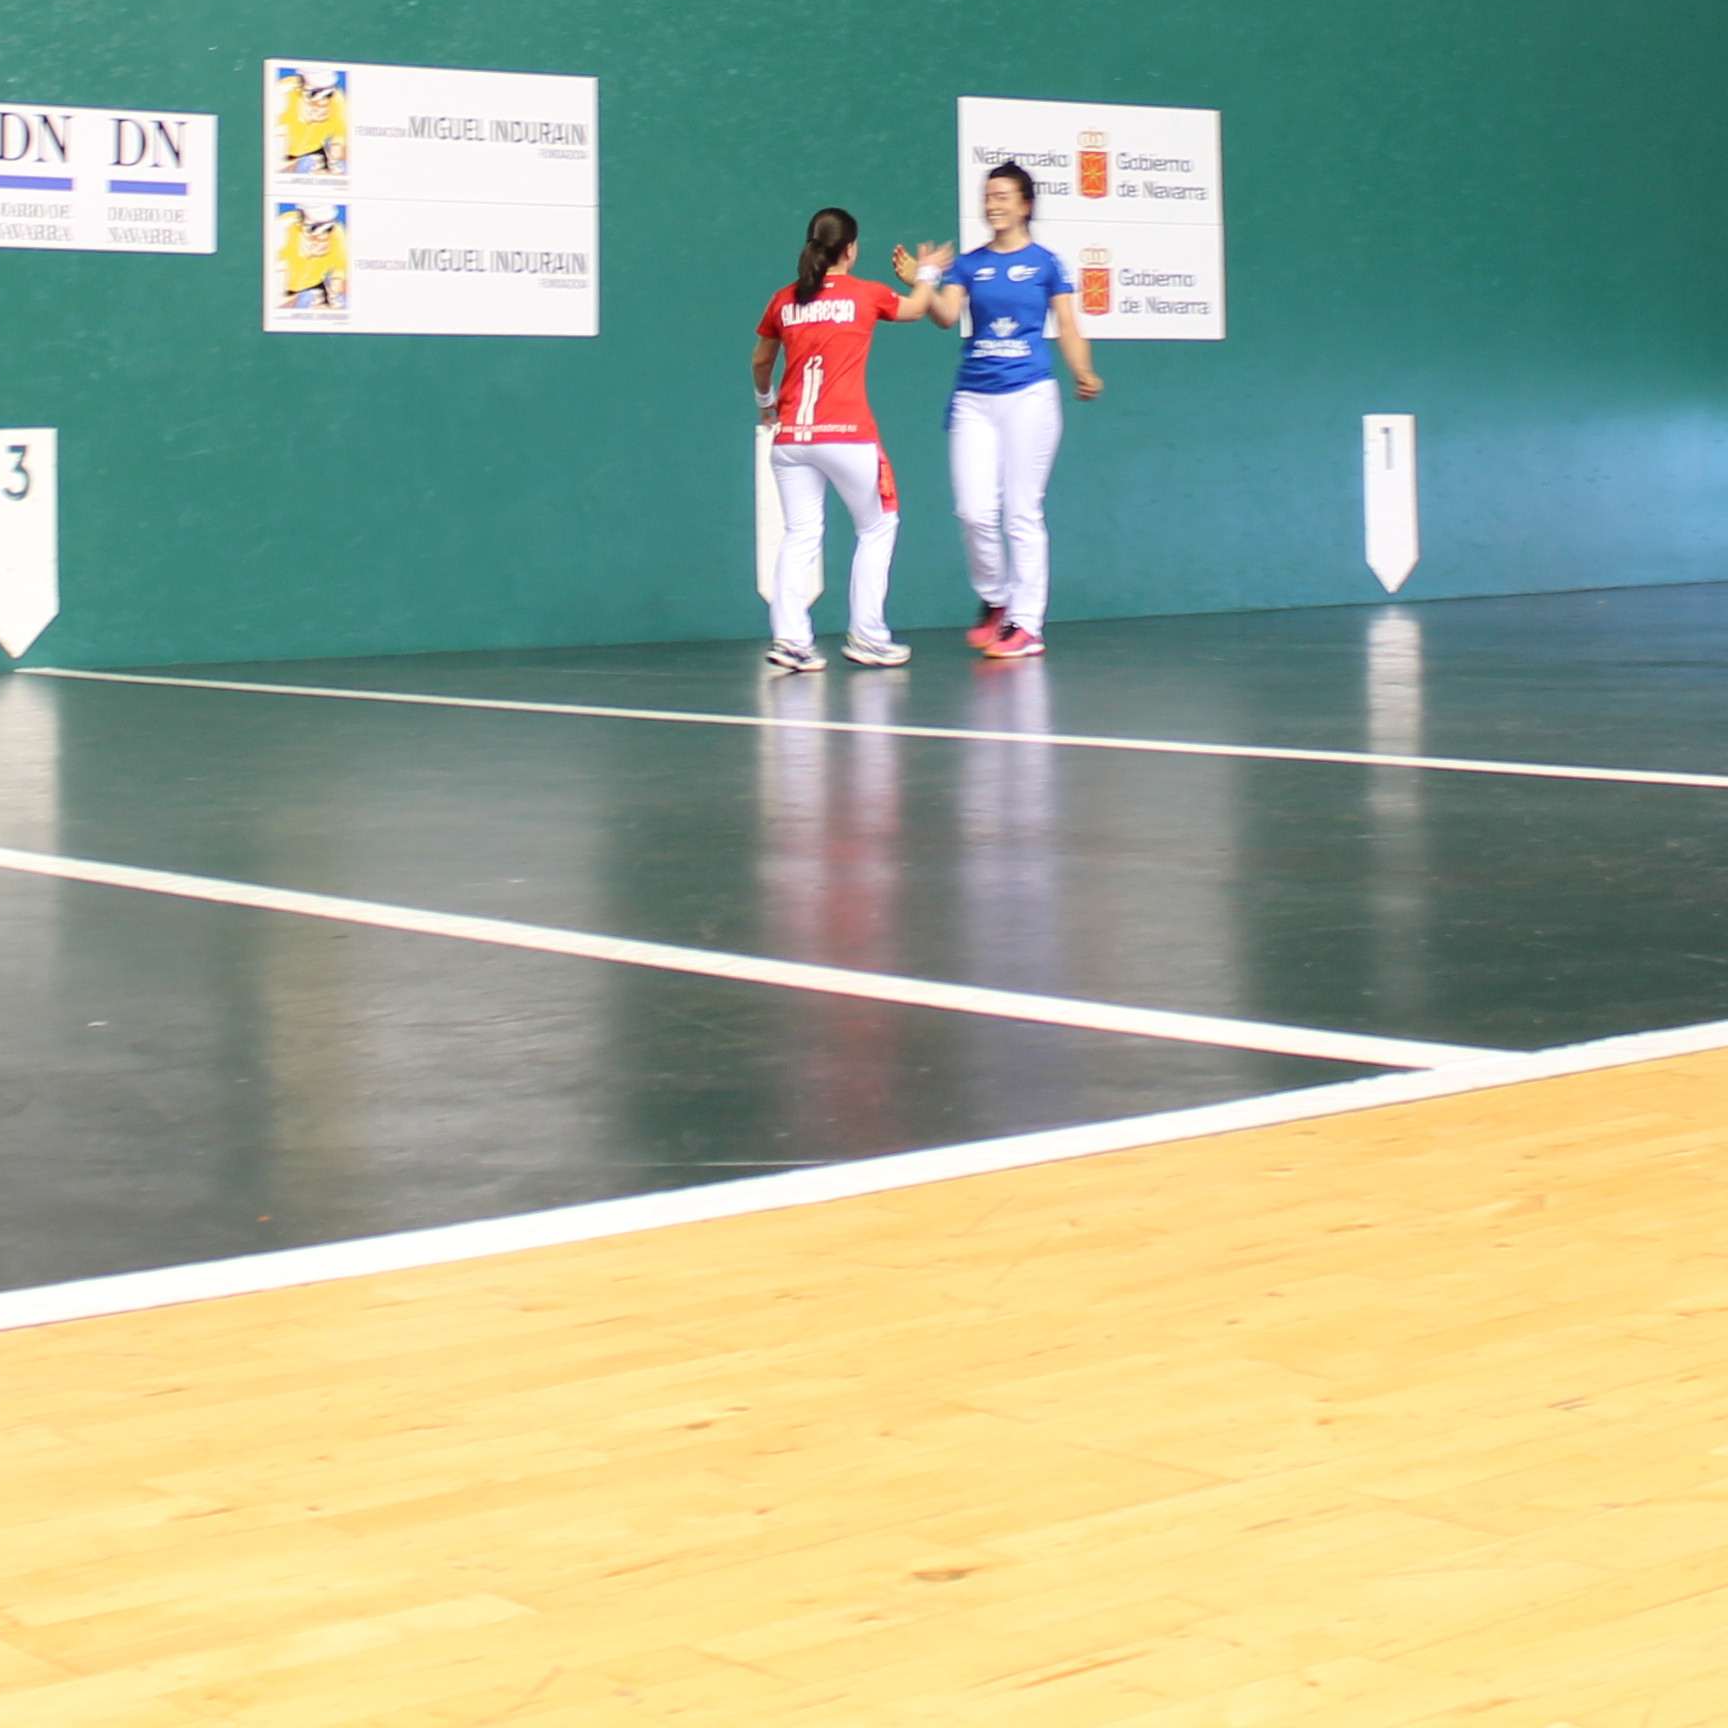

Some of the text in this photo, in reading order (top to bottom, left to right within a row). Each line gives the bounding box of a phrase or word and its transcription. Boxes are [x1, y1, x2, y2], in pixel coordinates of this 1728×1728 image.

[408, 115, 487, 142] MIGUEL
[109, 118, 190, 169] DN
[972, 146, 1070, 168] Nafarroako
[1116, 152, 1194, 172] Gobierno
[1117, 181, 1208, 200] de Navarra
[49, 203, 72, 220] DE
[107, 206, 188, 224] DIARIO DE
[107, 226, 189, 246] NAVARRA
[408, 247, 487, 273] MIGUEL
[1119, 268, 1196, 287] Gobierno
[1119, 297, 1211, 315] de Navarra
[1378, 426, 1394, 471] 1
[2, 443, 32, 502] 3
